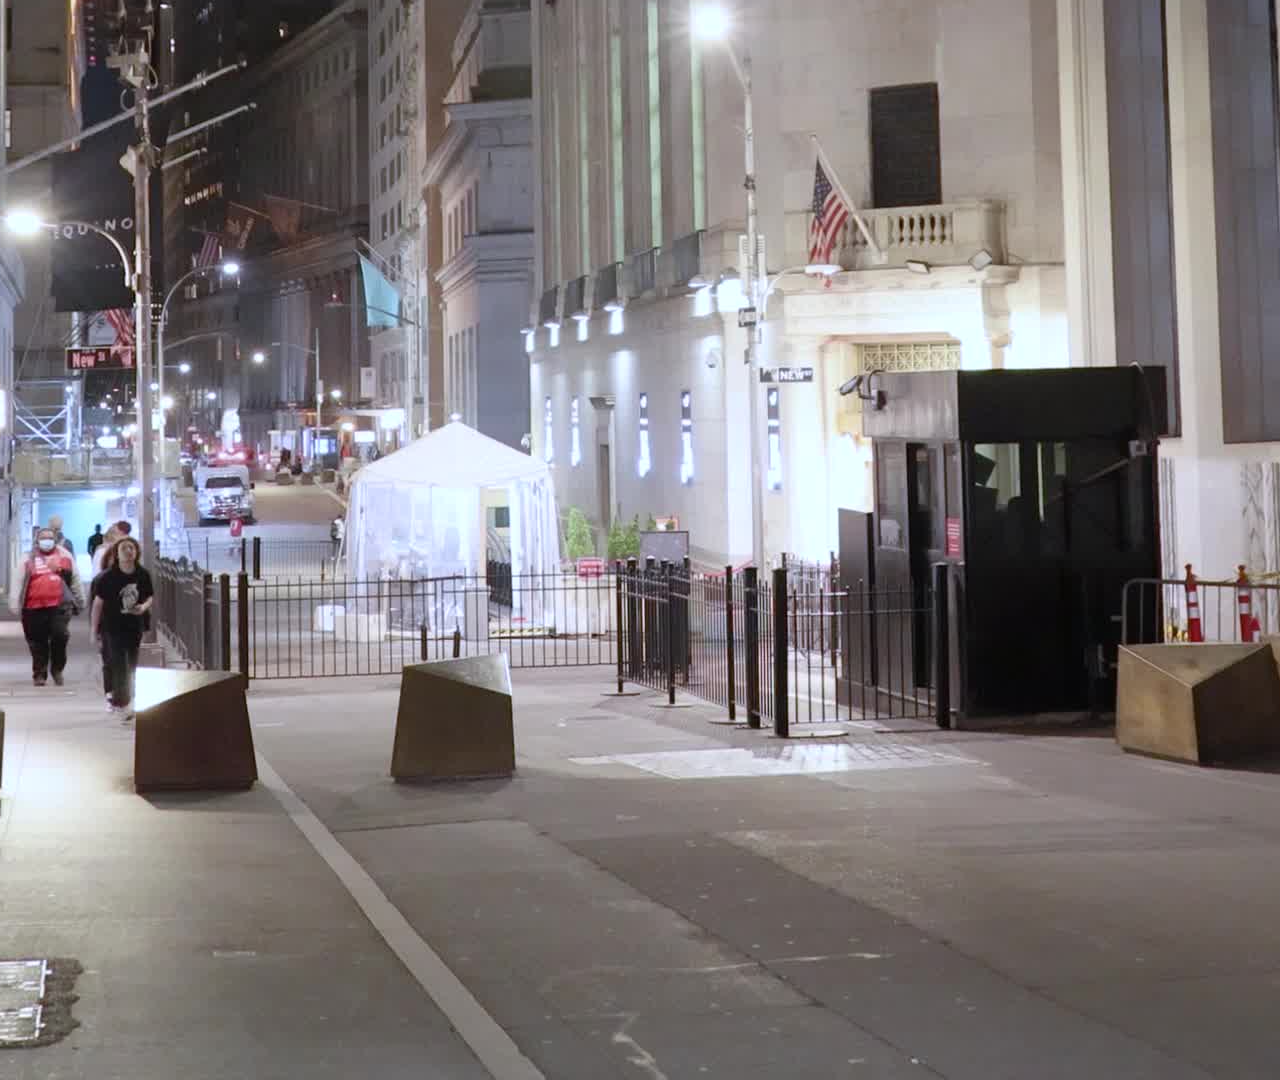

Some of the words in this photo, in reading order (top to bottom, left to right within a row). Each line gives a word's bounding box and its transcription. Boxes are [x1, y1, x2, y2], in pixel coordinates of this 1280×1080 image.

[52, 217, 134, 240] EQUNO
[72, 352, 96, 368] New
[779, 369, 804, 380] NEW
